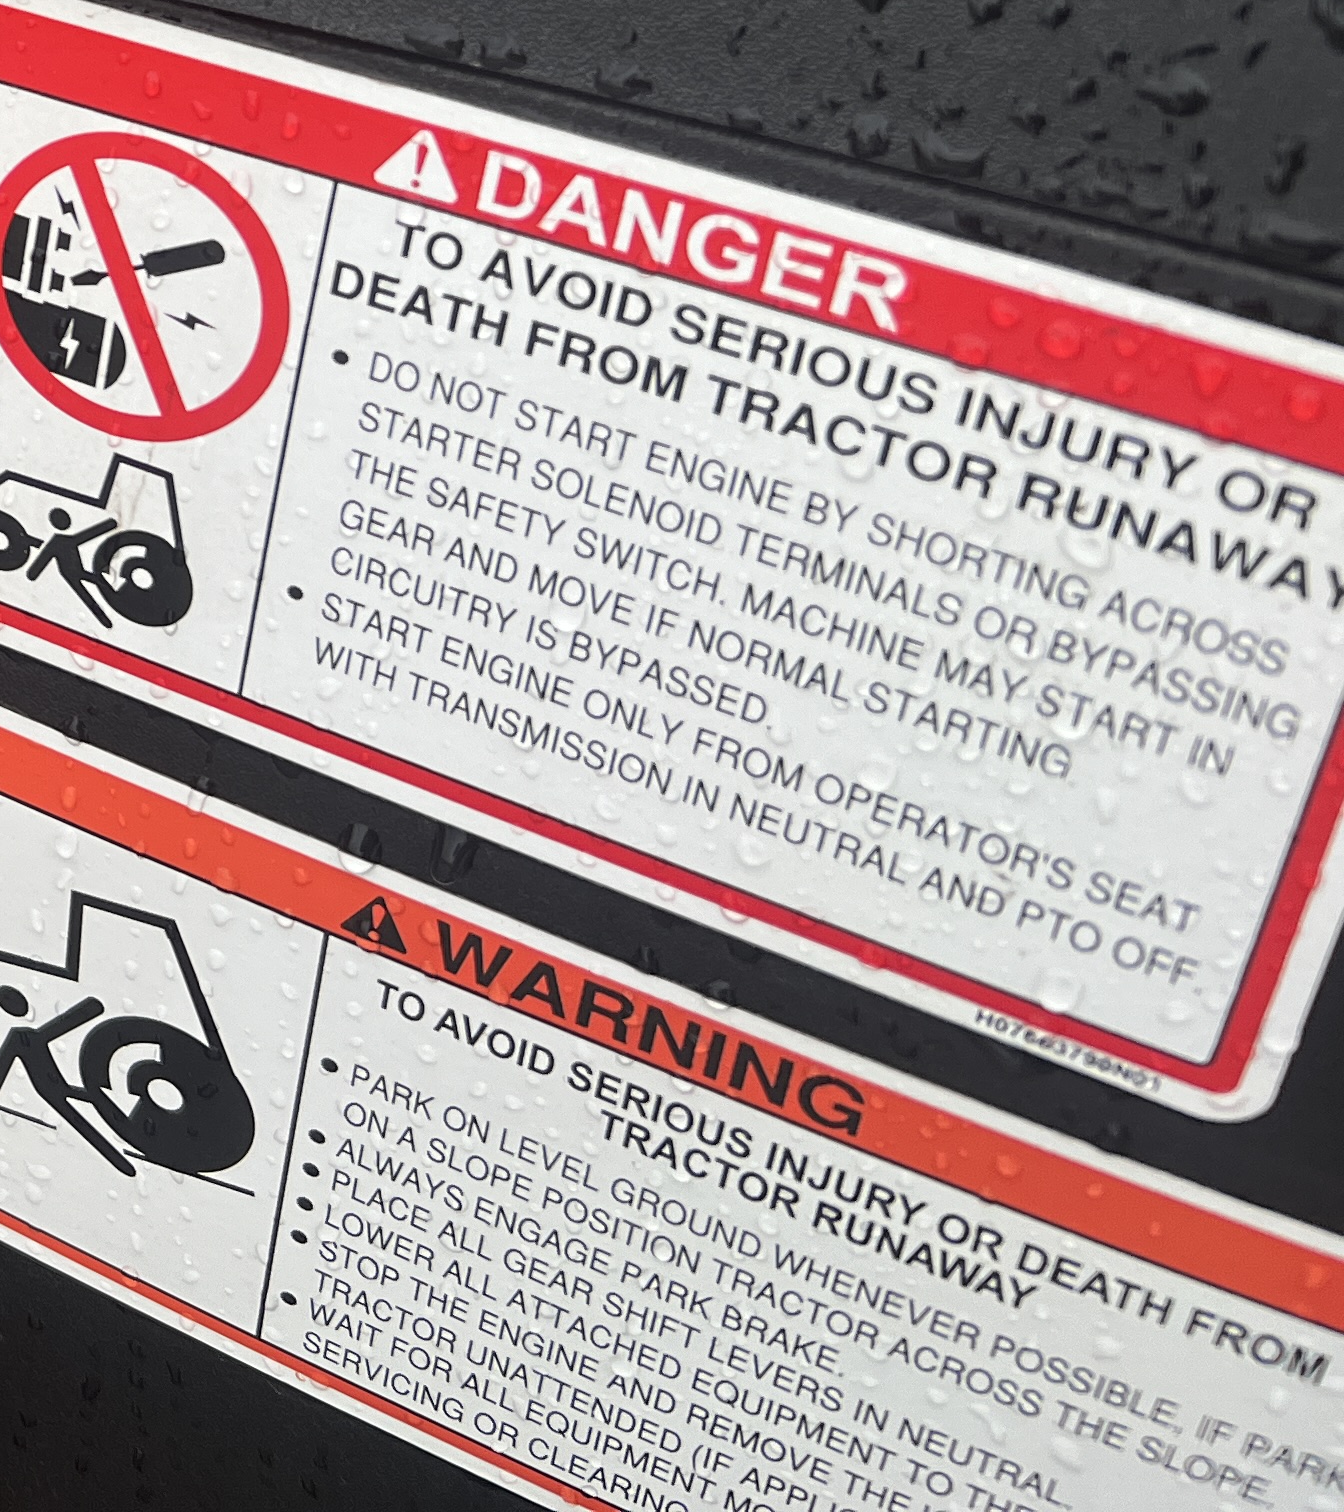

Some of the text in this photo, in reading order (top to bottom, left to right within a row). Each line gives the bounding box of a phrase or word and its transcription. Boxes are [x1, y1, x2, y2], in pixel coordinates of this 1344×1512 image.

[395, 219, 1317, 531] TO AVOID SERIOUS INJURY OR
[476, 149, 909, 334] DANGER
[330, 261, 509, 347] DEATH
[524, 319, 688, 402] FROM
[707, 373, 999, 500] TRACTOR
[369, 351, 1291, 677] DO NOT START ENGINE BY SHORTING ACROSS
[330, 547, 773, 730] CIRCUITRY IS BYPASSED.
[339, 499, 1073, 780] GEAR AND MOVE IF NORMAL STARTING
[351, 449, 1234, 777] THE SAFETY SWITCH. MACHINE MAY START IN
[358, 401, 1302, 742] STARTER SOLENOID TERMINALS OR BYPASSING
[315, 637, 397, 692] WITH
[409, 671, 672, 795] TRANSMISSION
[683, 776, 720, 812] IN
[729, 794, 906, 885] NEUTRAL
[918, 868, 1005, 917] AND
[1015, 900, 1101, 953] PTO
[321, 593, 1201, 933] START ENGINE ONLY FROM OPERATOR'S SEAT
[437, 920, 866, 1136] WARNING
[332, 1170, 432, 1232] PLACE
[438, 1222, 491, 1261] ALL
[504, 1248, 594, 1305] GEAR
[603, 1292, 701, 1348] SHIFT
[709, 1336, 844, 1412] LEVERS
[854, 1399, 889, 1431] IN
[337, 1139, 844, 1377] ALWAYS ENGAGE PARK BRAKE.
[344, 1101, 390, 1140] ON
[398, 1122, 417, 1152] A
[427, 1137, 534, 1201] SLOPE
[542, 1188, 701, 1275] POSITION
[712, 1259, 881, 1348] TRACTOR
[888, 1338, 1043, 1416] ACROSS
[1056, 1400, 1129, 1450] THE
[352, 1064, 434, 1121] PARK
[443, 1105, 489, 1143] ON
[500, 1128, 599, 1190] LEVEL
[612, 1177, 761, 1257] GROUND
[774, 1244, 981, 1350] WHENEVER
[1195, 1417, 1237, 1445] IF
[376, 979, 1331, 1386] TO AVOID SERIOUS INJURY OR DEATH FROM
[600, 1109, 1039, 1309] TRACTOR RUNAWAY
[303, 1331, 465, 1423] SERVICING
[474, 1412, 520, 1447] OR
[310, 1297, 383, 1346] WAIT
[390, 1339, 453, 1383] FOR
[461, 1374, 514, 1412] ALL
[525, 1401, 717, 1499] EQUIPMENT
[314, 1269, 458, 1352] TRACTOR
[467, 1342, 683, 1455] UNATTENDED
[692, 1444, 733, 1474] (IF
[319, 1241, 400, 1285] STOP
[410, 1276, 468, 1323] THE
[479, 1312, 599, 1381] ENGINE
[607, 1374, 678, 1415] AND
[686, 1402, 833, 1485] REMOVE
[325, 1205, 434, 1272] LOWER
[443, 1260, 497, 1301] ALL
[506, 1292, 682, 1380] ATTACHED
[692, 1368, 898, 1471] EQUIPMENT
[907, 1458, 953, 1496] TO
